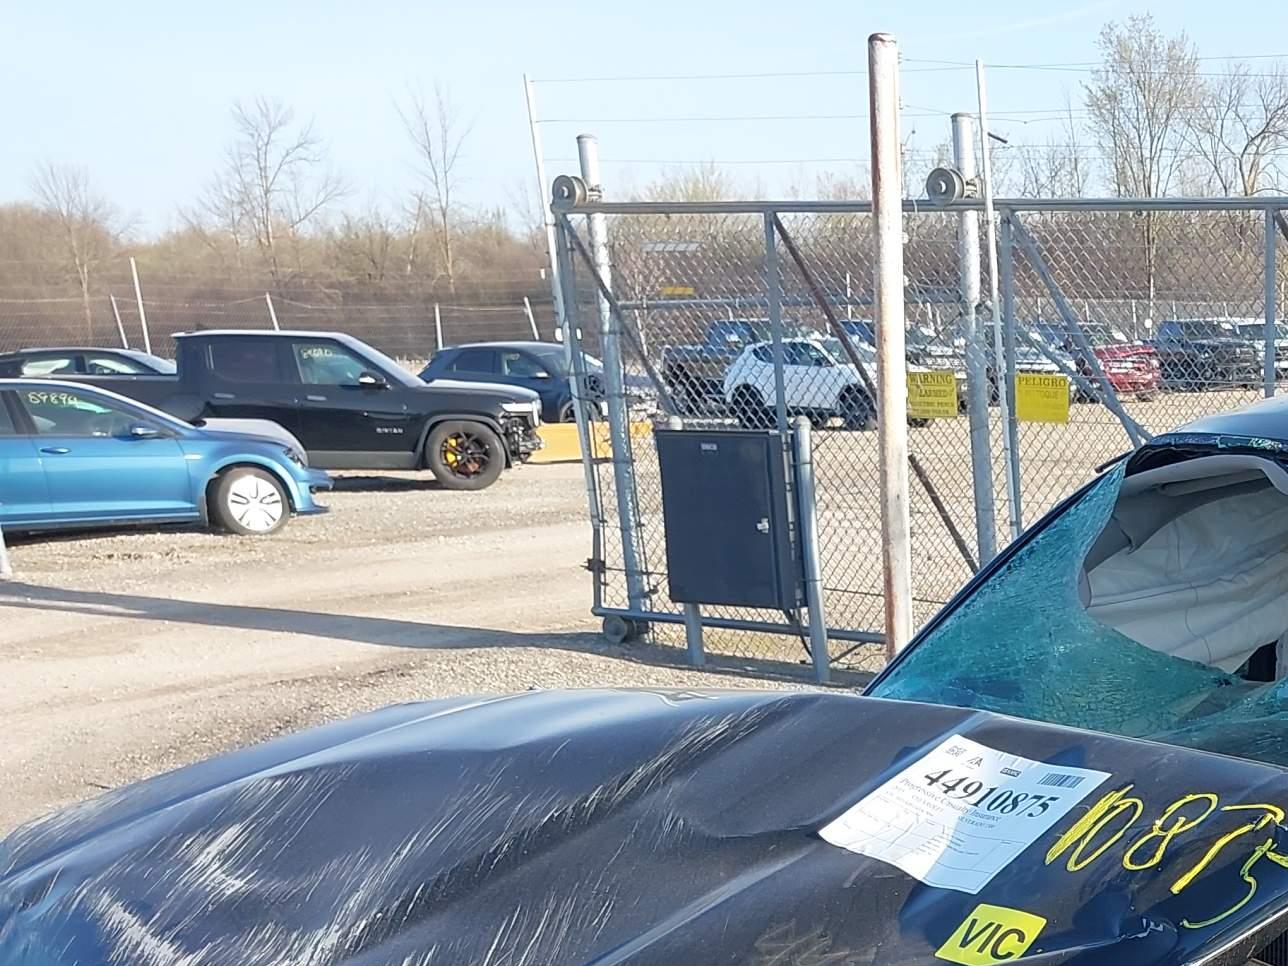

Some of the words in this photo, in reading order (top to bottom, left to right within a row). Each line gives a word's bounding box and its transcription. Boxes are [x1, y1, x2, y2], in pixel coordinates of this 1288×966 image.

[909, 373, 953, 385] WARNING
[1018, 376, 1066, 388] PELIGRO
[924, 769, 1060, 818] 44910875
[959, 918, 1026, 960] VIC
